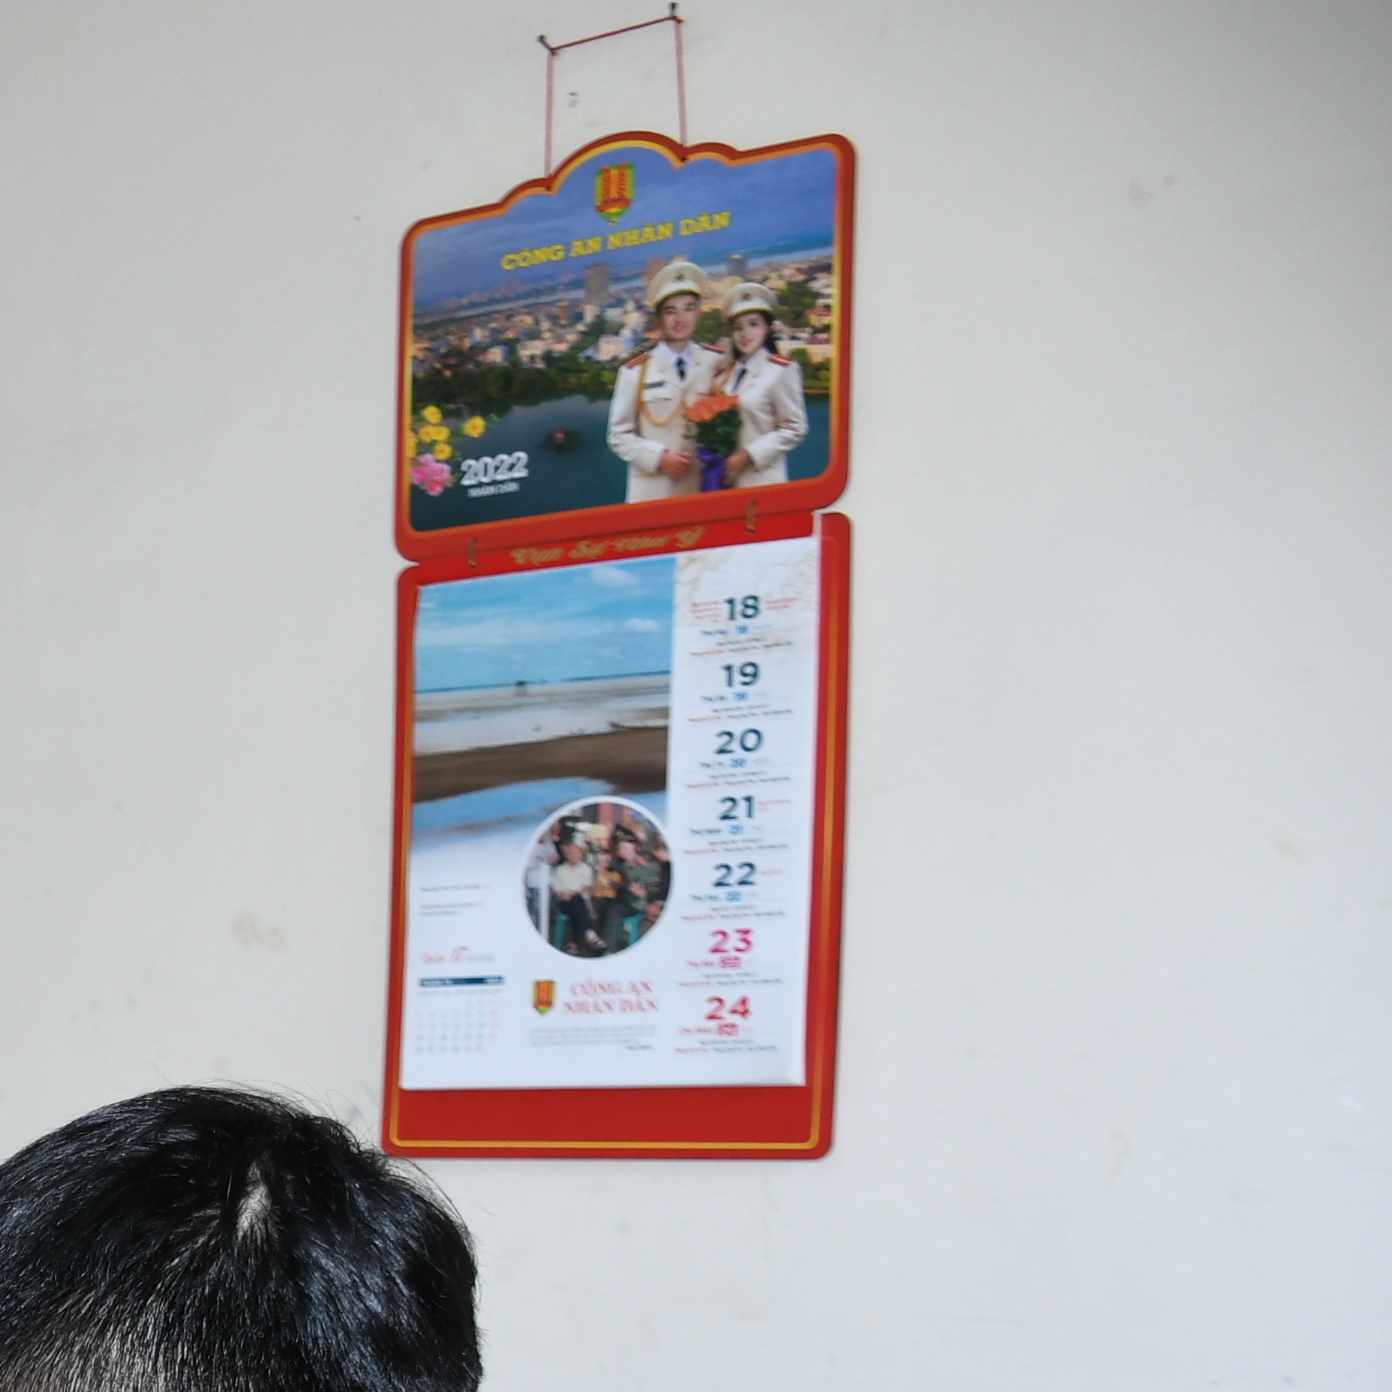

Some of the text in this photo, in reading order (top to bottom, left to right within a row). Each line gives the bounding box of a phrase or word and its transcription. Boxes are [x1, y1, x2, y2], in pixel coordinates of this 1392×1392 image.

[501, 211, 731, 270] CÔNG AN NHÂN DÂN
[460, 451, 529, 486] 2022
[724, 594, 760, 621] 18
[721, 661, 760, 688] 19
[714, 727, 764, 754] 20
[718, 794, 755, 820] 21
[712, 861, 757, 887] 22
[709, 928, 753, 953] 23
[705, 995, 752, 1021] 24
